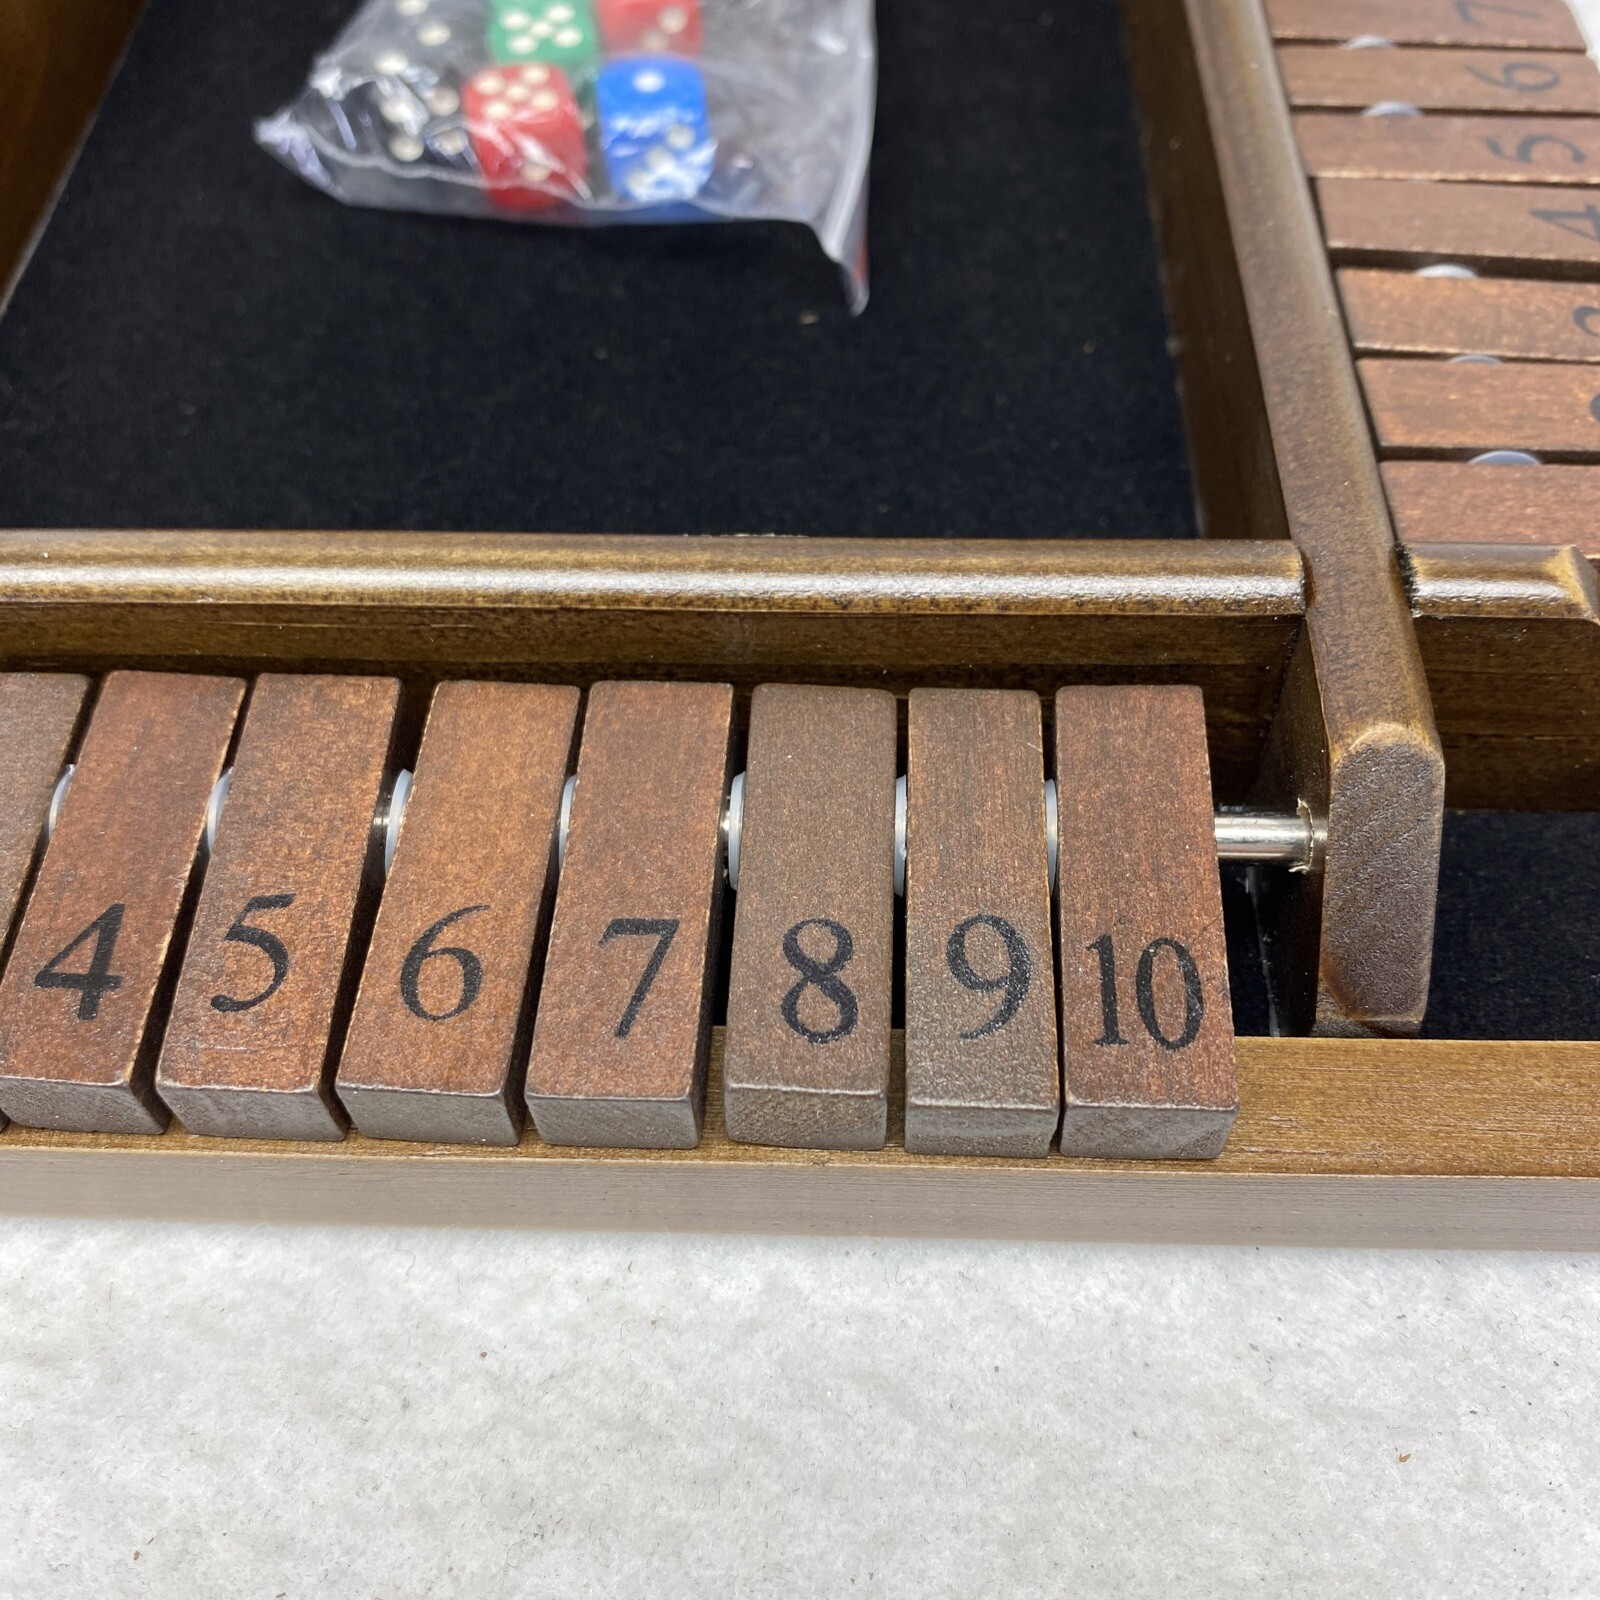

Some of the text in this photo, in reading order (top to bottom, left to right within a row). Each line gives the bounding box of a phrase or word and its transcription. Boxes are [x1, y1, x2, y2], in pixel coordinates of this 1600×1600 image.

[1455, 0, 1541, 28] 7
[1464, 61, 1561, 92] 6
[1483, 134, 1587, 164] 5
[1528, 203, 1600, 243] 4
[34, 902, 124, 1022] 4
[210, 893, 297, 1013] 5
[399, 904, 490, 1022] 6
[599, 917, 680, 1039] 7
[780, 917, 859, 1045] 8
[946, 913, 1031, 1040] 9
[1085, 933, 1205, 1052] 10
